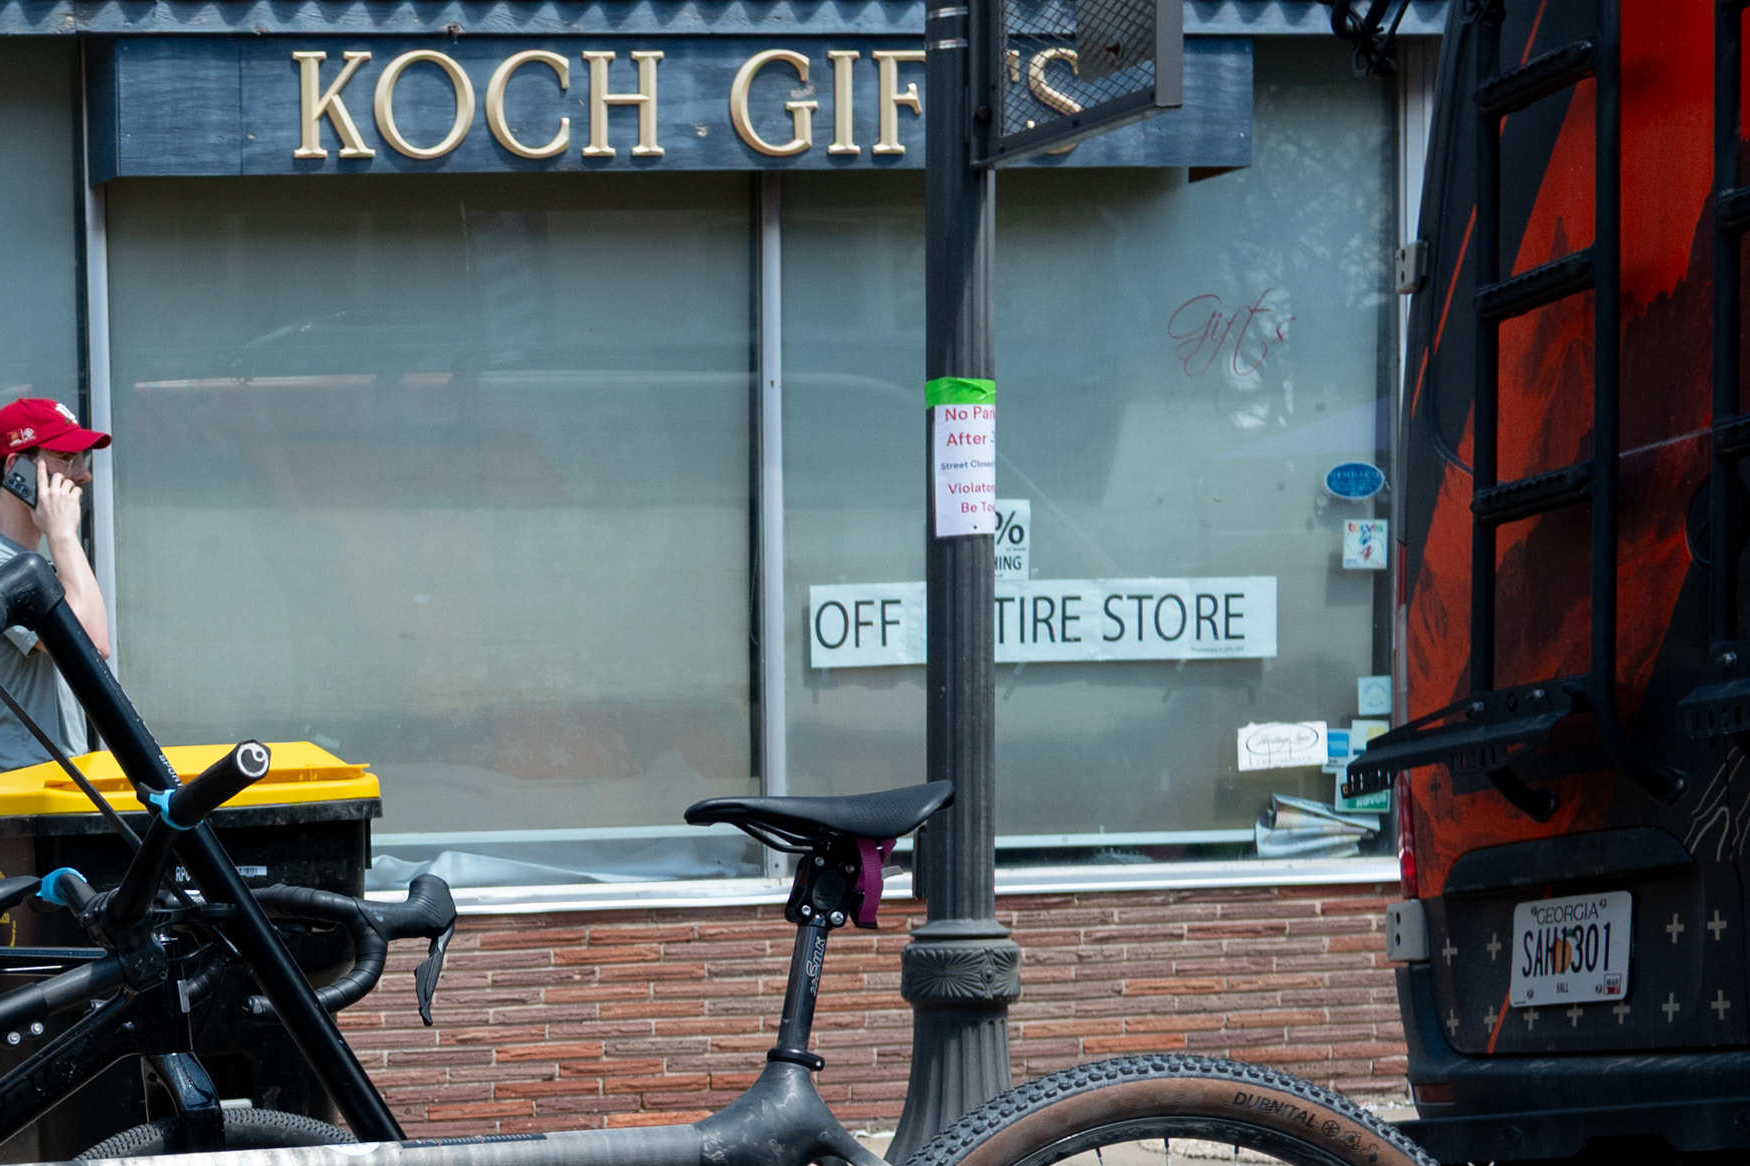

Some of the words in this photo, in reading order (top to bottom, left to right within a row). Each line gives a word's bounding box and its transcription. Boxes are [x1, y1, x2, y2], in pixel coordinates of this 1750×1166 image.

[292, 50, 665, 159] KOCH
[730, 47, 1082, 156] GIFS
[945, 407, 968, 421] No
[973, 405, 995, 420] Par
[946, 431, 987, 447] After
[940, 461, 968, 471] Street
[961, 502, 977, 513] Be
[814, 599, 902, 650] OFF
[1102, 591, 1246, 643] STORE
[1536, 902, 1600, 926] GEORGIA
[1522, 922, 1611, 978] SAH1301
[1556, 982, 1569, 994] HALL
[1233, 1091, 1317, 1128] DUBNITAL
